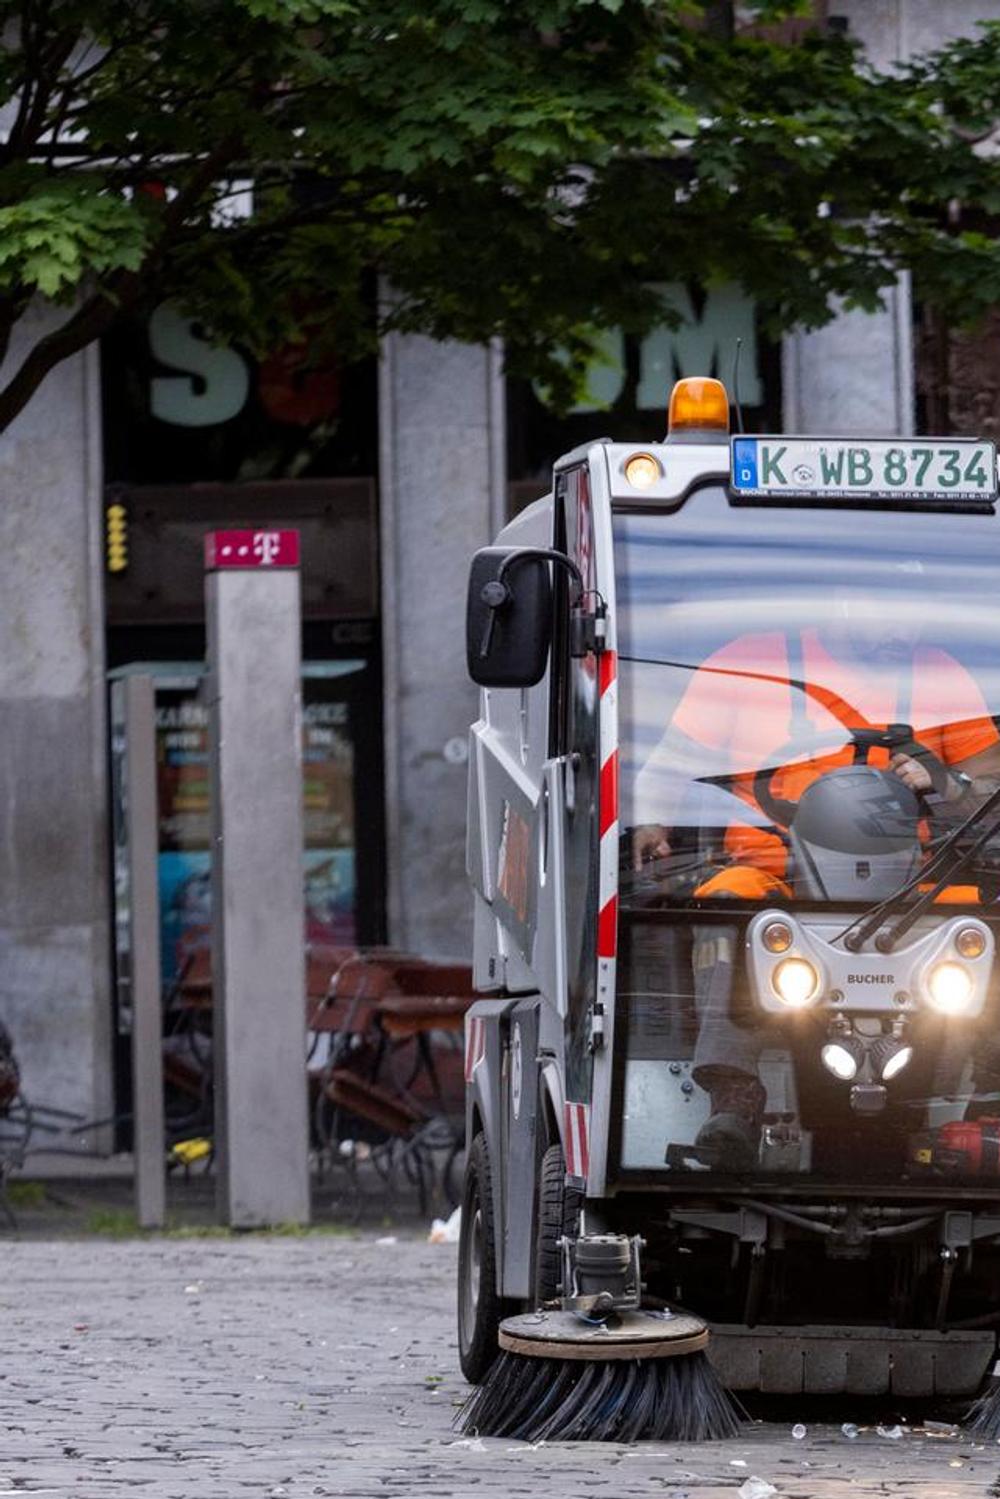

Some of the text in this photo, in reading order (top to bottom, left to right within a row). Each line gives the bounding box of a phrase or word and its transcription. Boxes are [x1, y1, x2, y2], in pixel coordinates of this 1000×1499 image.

[761, 446, 988, 487] K WB 8734
[741, 470, 752, 481] D
[847, 974, 895, 984] BUCHER
